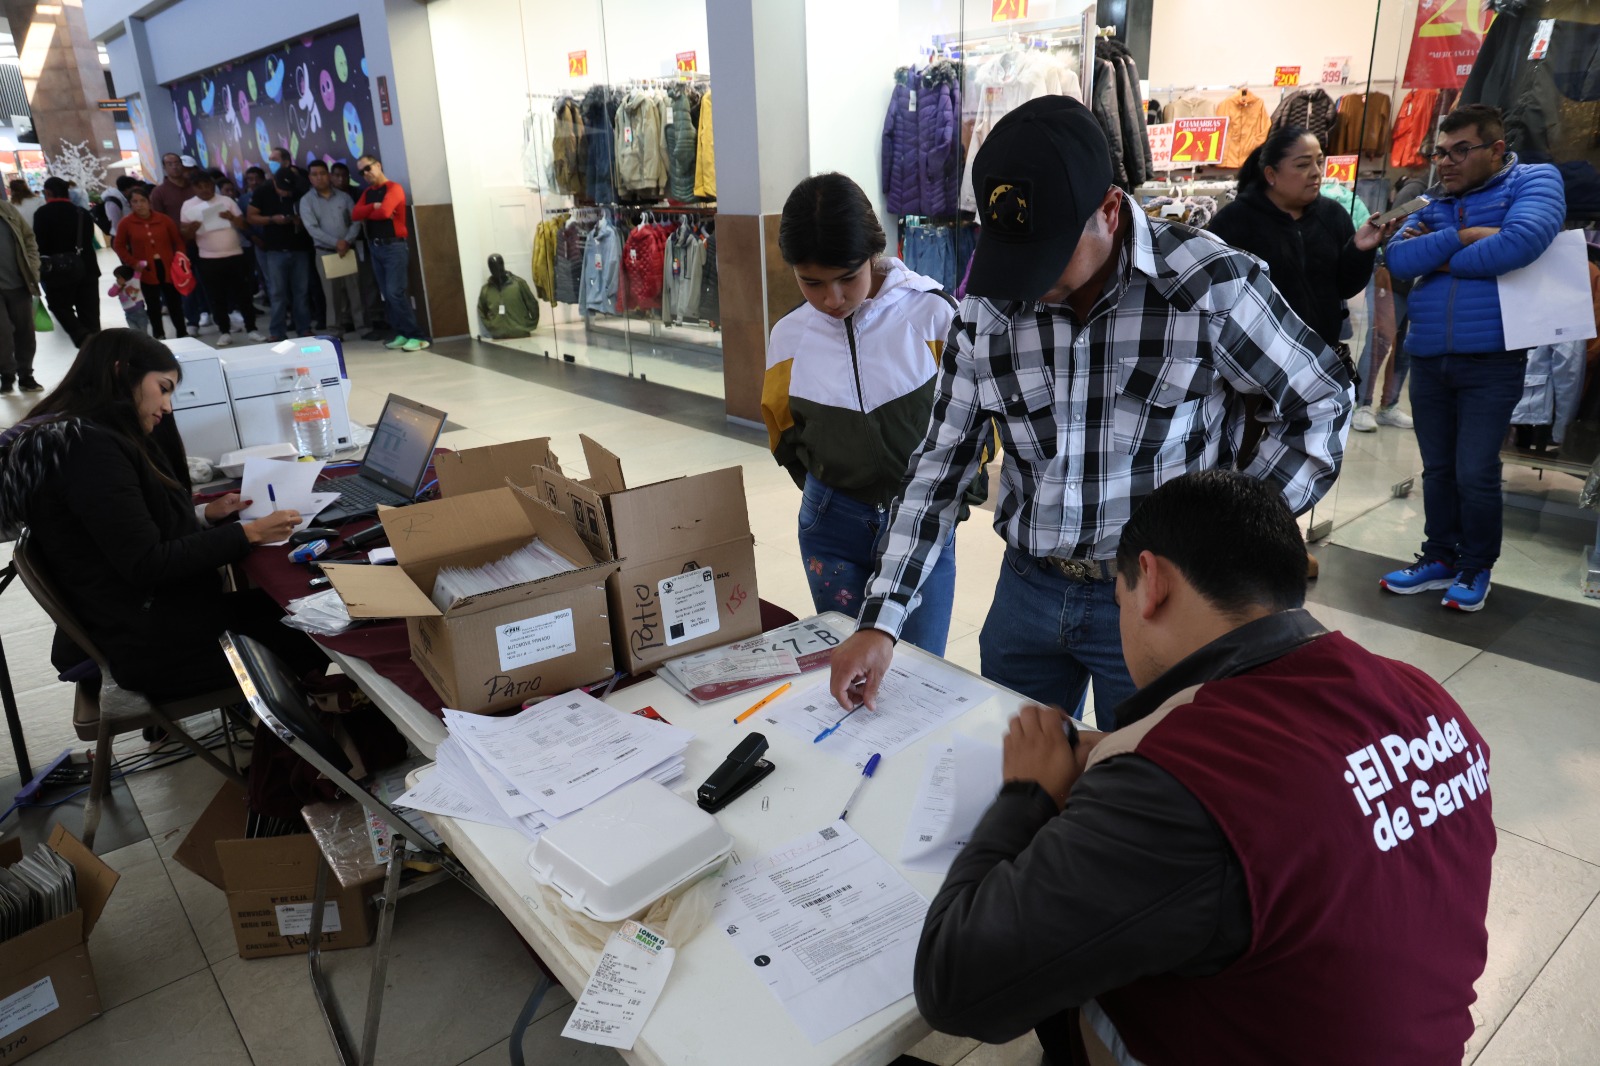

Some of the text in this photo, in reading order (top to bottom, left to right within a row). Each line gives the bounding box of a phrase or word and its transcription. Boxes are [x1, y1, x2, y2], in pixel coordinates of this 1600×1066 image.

[1322, 71, 1341, 83] 399
[1179, 120, 1221, 128] CHAMARRAS
[1380, 714, 1468, 783] Poder
[1373, 800, 1414, 852] de
